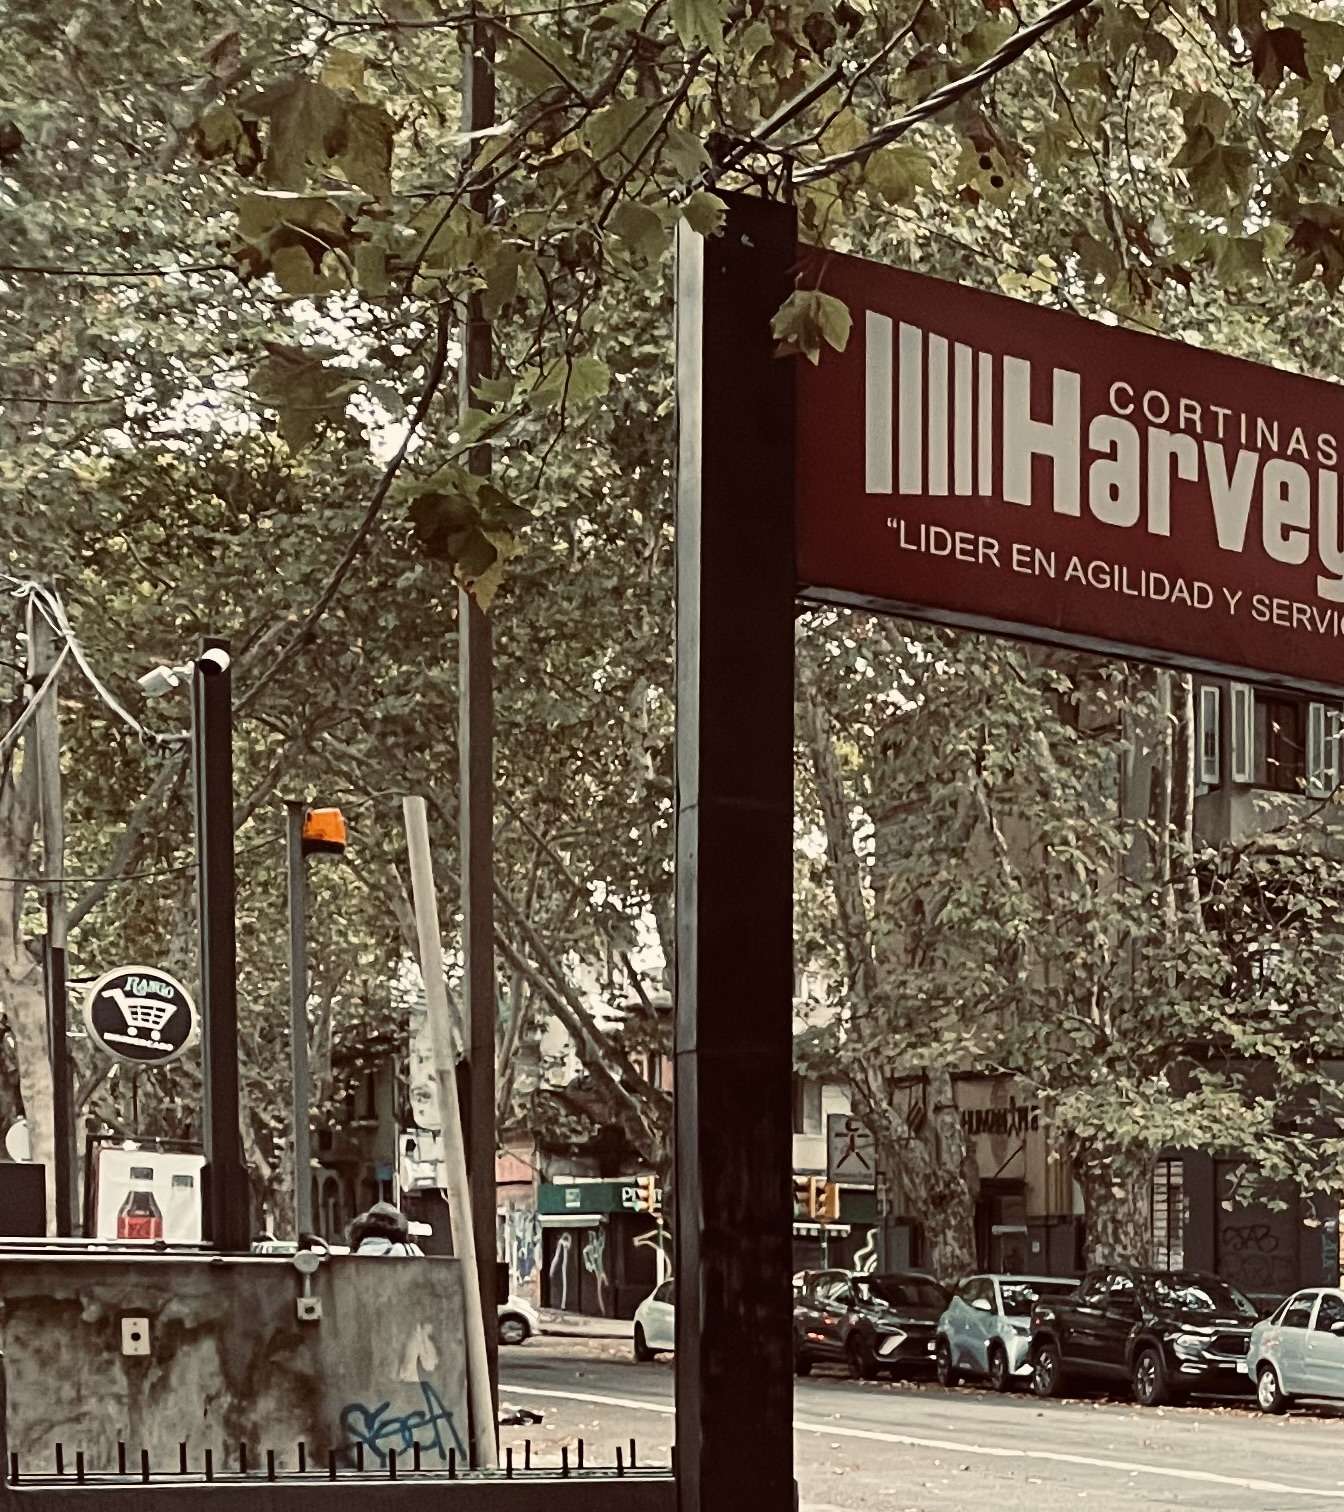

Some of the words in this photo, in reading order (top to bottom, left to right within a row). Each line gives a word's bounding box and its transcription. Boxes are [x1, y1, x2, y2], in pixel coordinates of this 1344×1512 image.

[1109, 381, 1338, 467] CORTINAS
[1012, 543, 1055, 578] EN
[1064, 556, 1213, 609] AGILIDAD
[1223, 587, 1243, 615] Y
